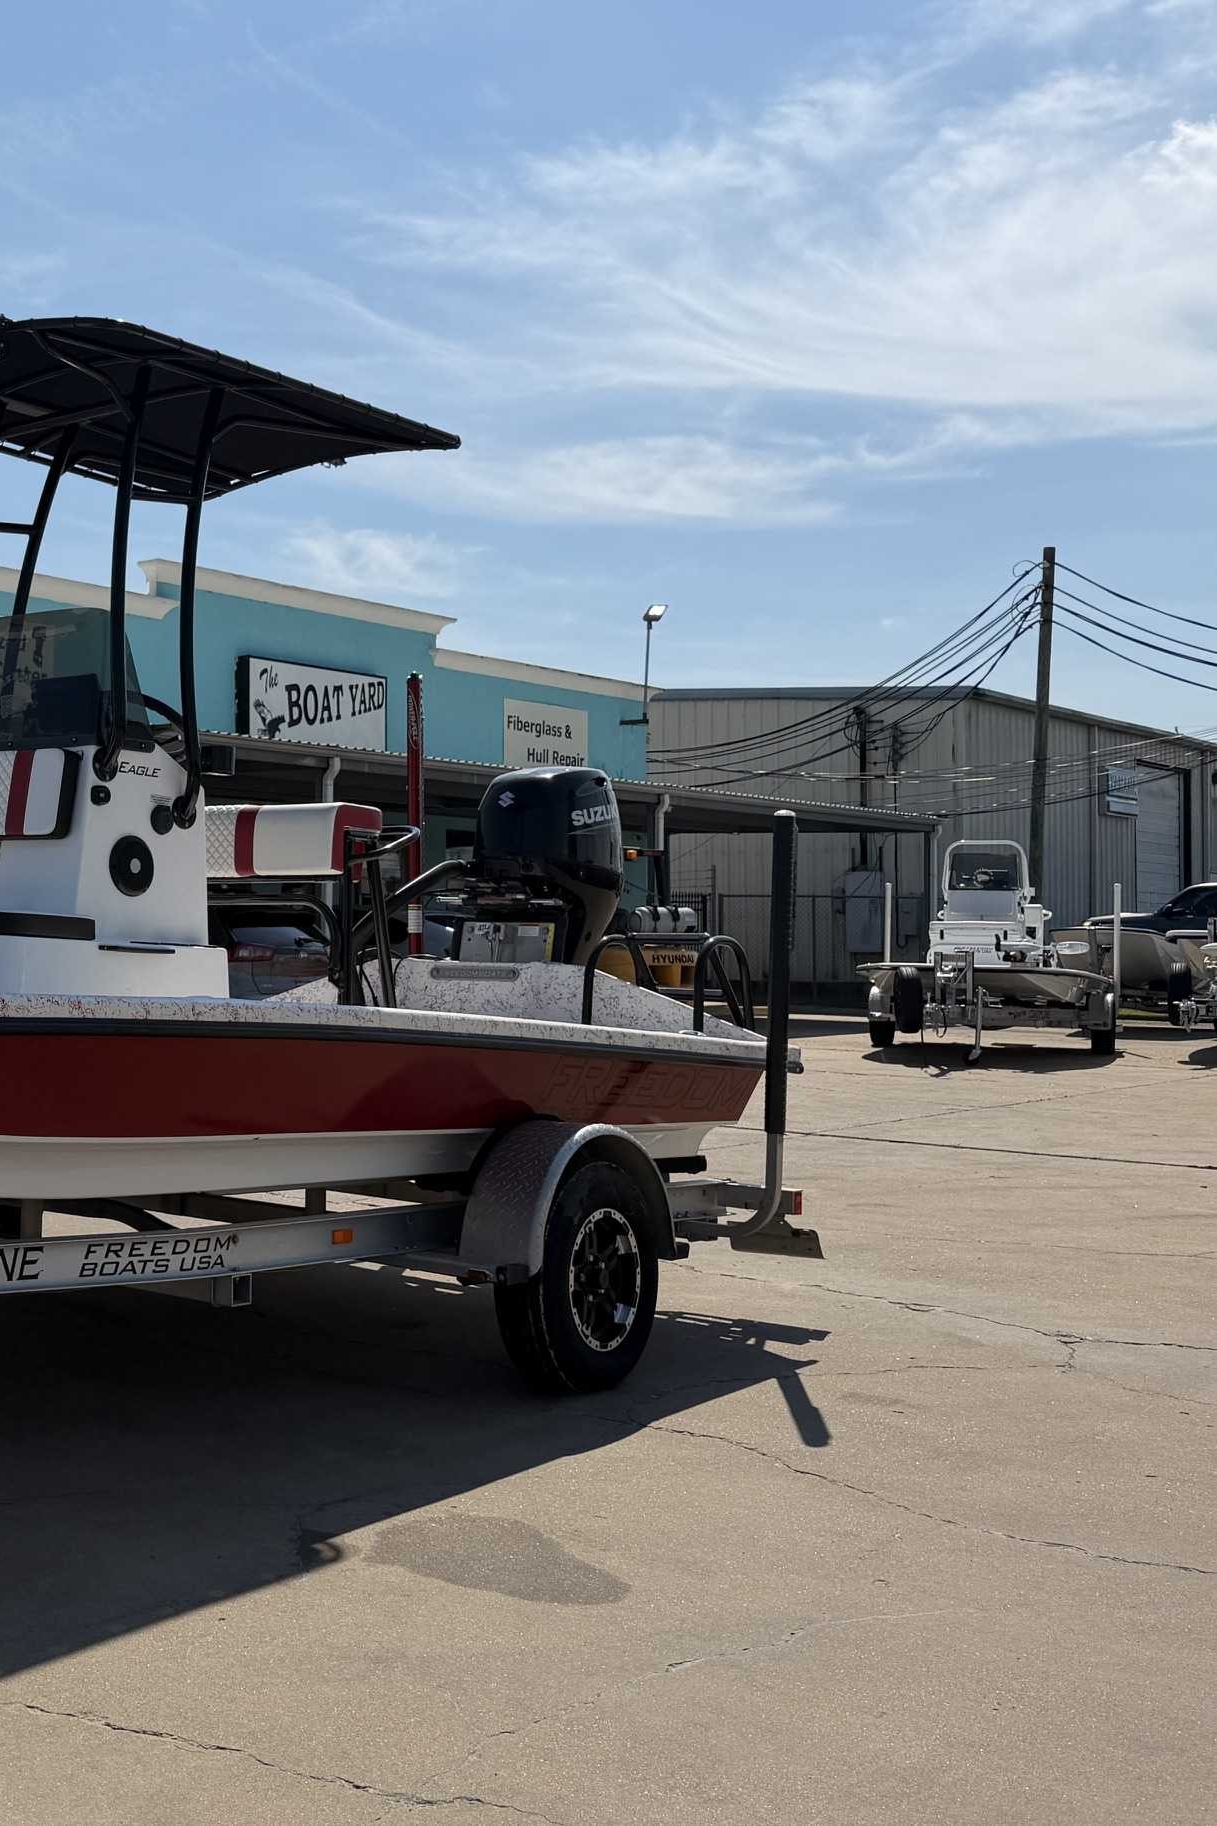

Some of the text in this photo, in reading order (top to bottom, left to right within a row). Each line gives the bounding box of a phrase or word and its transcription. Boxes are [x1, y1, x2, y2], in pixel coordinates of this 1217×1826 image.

[259, 664, 279, 693] The
[285, 681, 384, 728] BOAT YARD
[507, 714, 572, 739] Fiberglass &
[527, 747, 585, 767] Hull Repair
[119, 761, 161, 778] EAGLE
[570, 804, 619, 826] SUZUK
[546, 1054, 747, 1112] FREEDOM
[79, 1254, 225, 1278] BOATS USA
